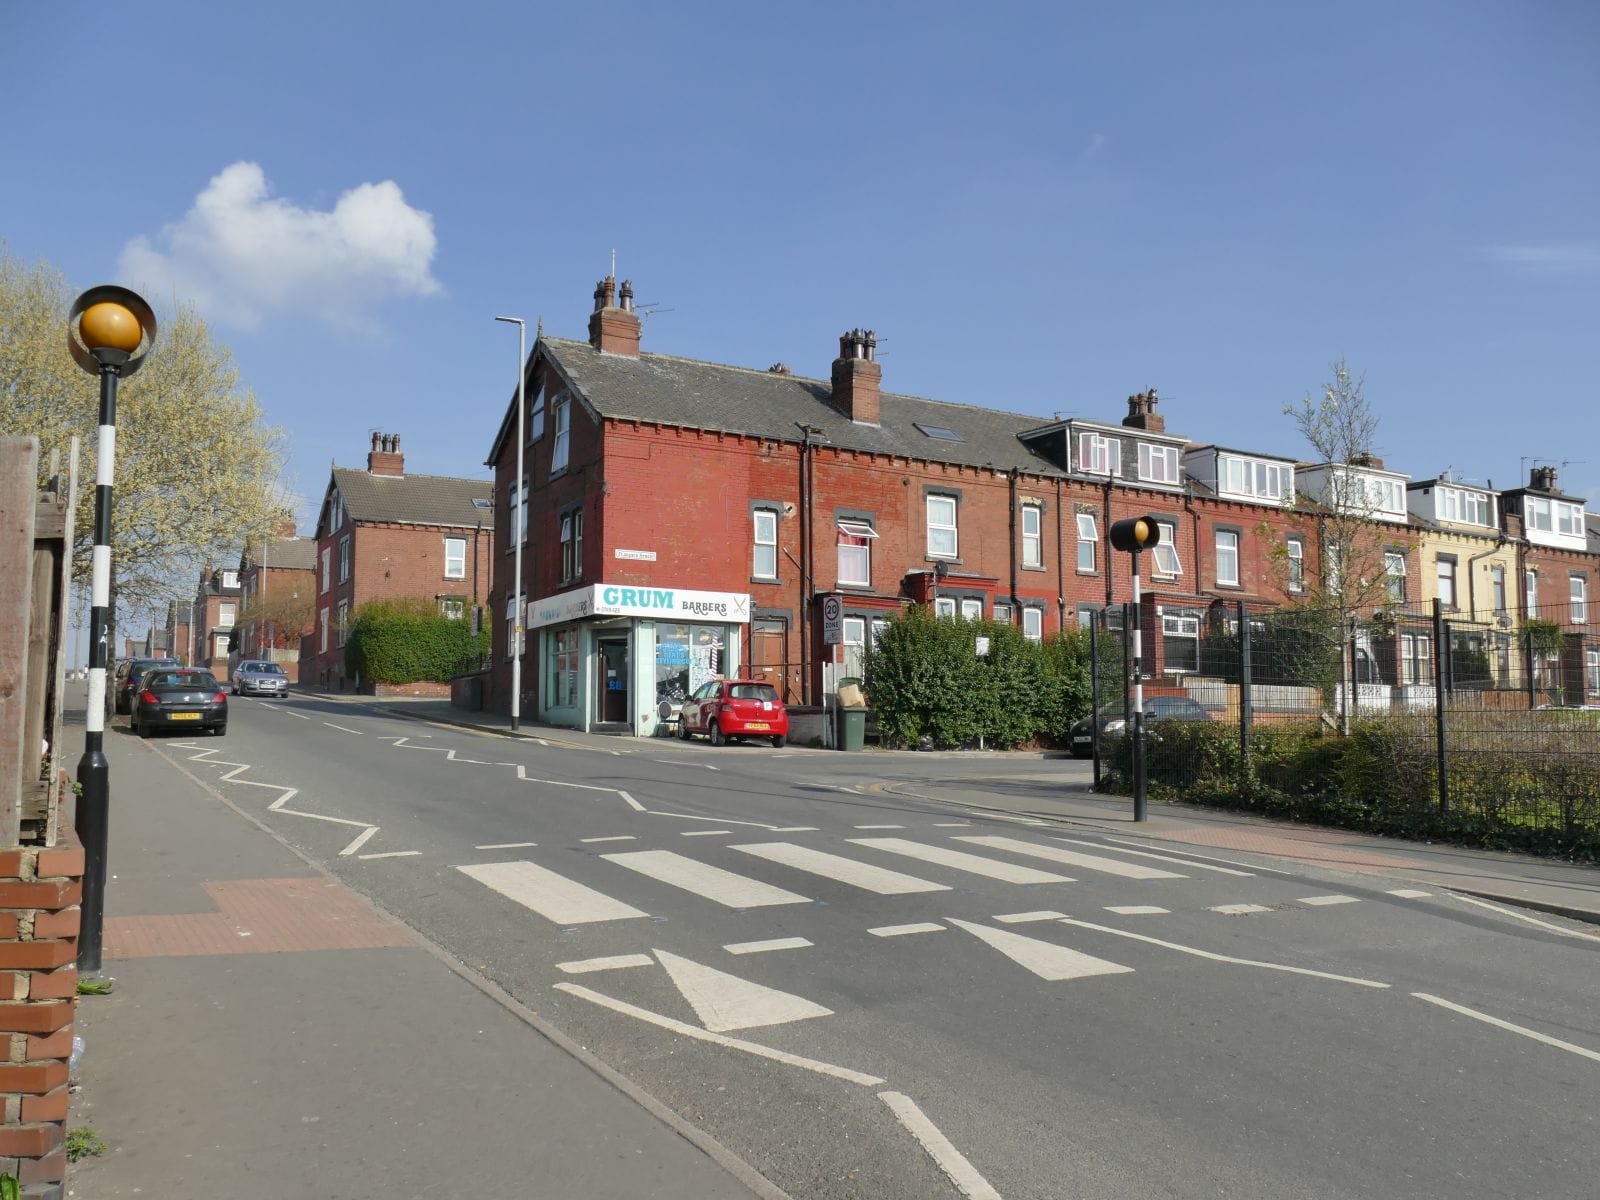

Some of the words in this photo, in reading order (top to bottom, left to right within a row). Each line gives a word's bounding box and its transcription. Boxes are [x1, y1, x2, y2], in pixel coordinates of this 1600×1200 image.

[603, 587, 674, 609] GRUM
[682, 601, 728, 616] BARBERS
[826, 605, 837, 614] 20
